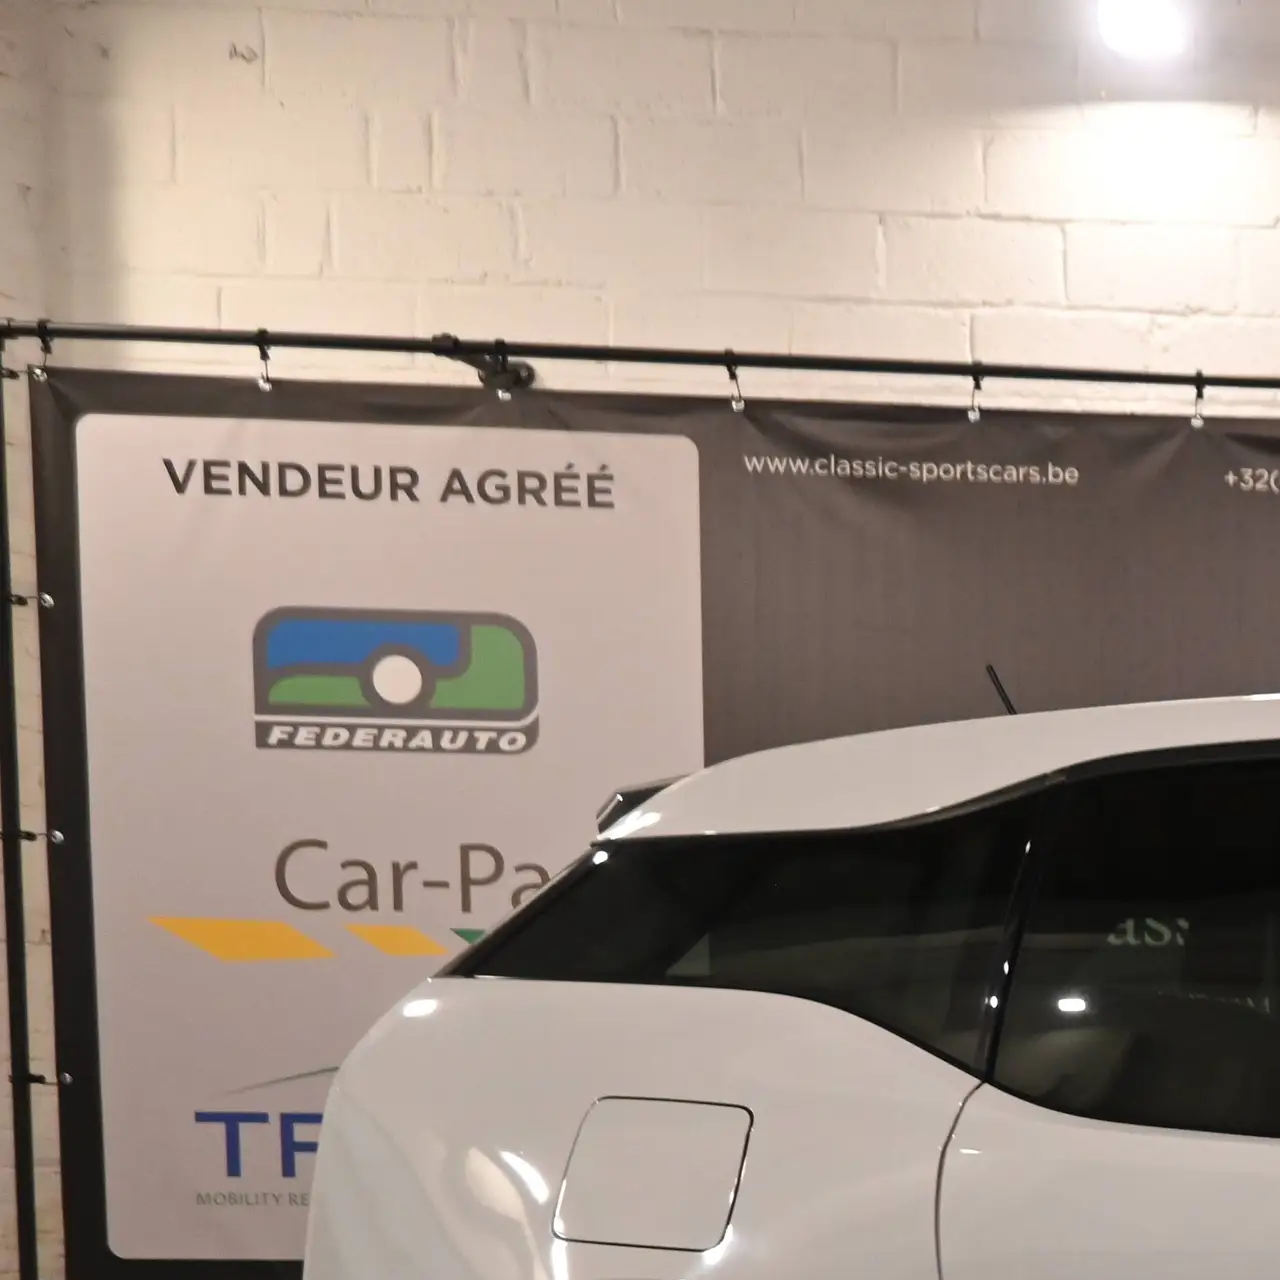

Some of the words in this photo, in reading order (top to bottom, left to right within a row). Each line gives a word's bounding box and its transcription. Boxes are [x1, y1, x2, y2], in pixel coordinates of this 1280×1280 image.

[162, 457, 421, 502] VENDEUR
[439, 461, 616, 509] AGRÉÉ
[742, 453, 1080, 485] www.classic-sportscars.be
[266, 724, 527, 751] FEDERAUTO
[195, 1191, 281, 1206] MOBILITY
